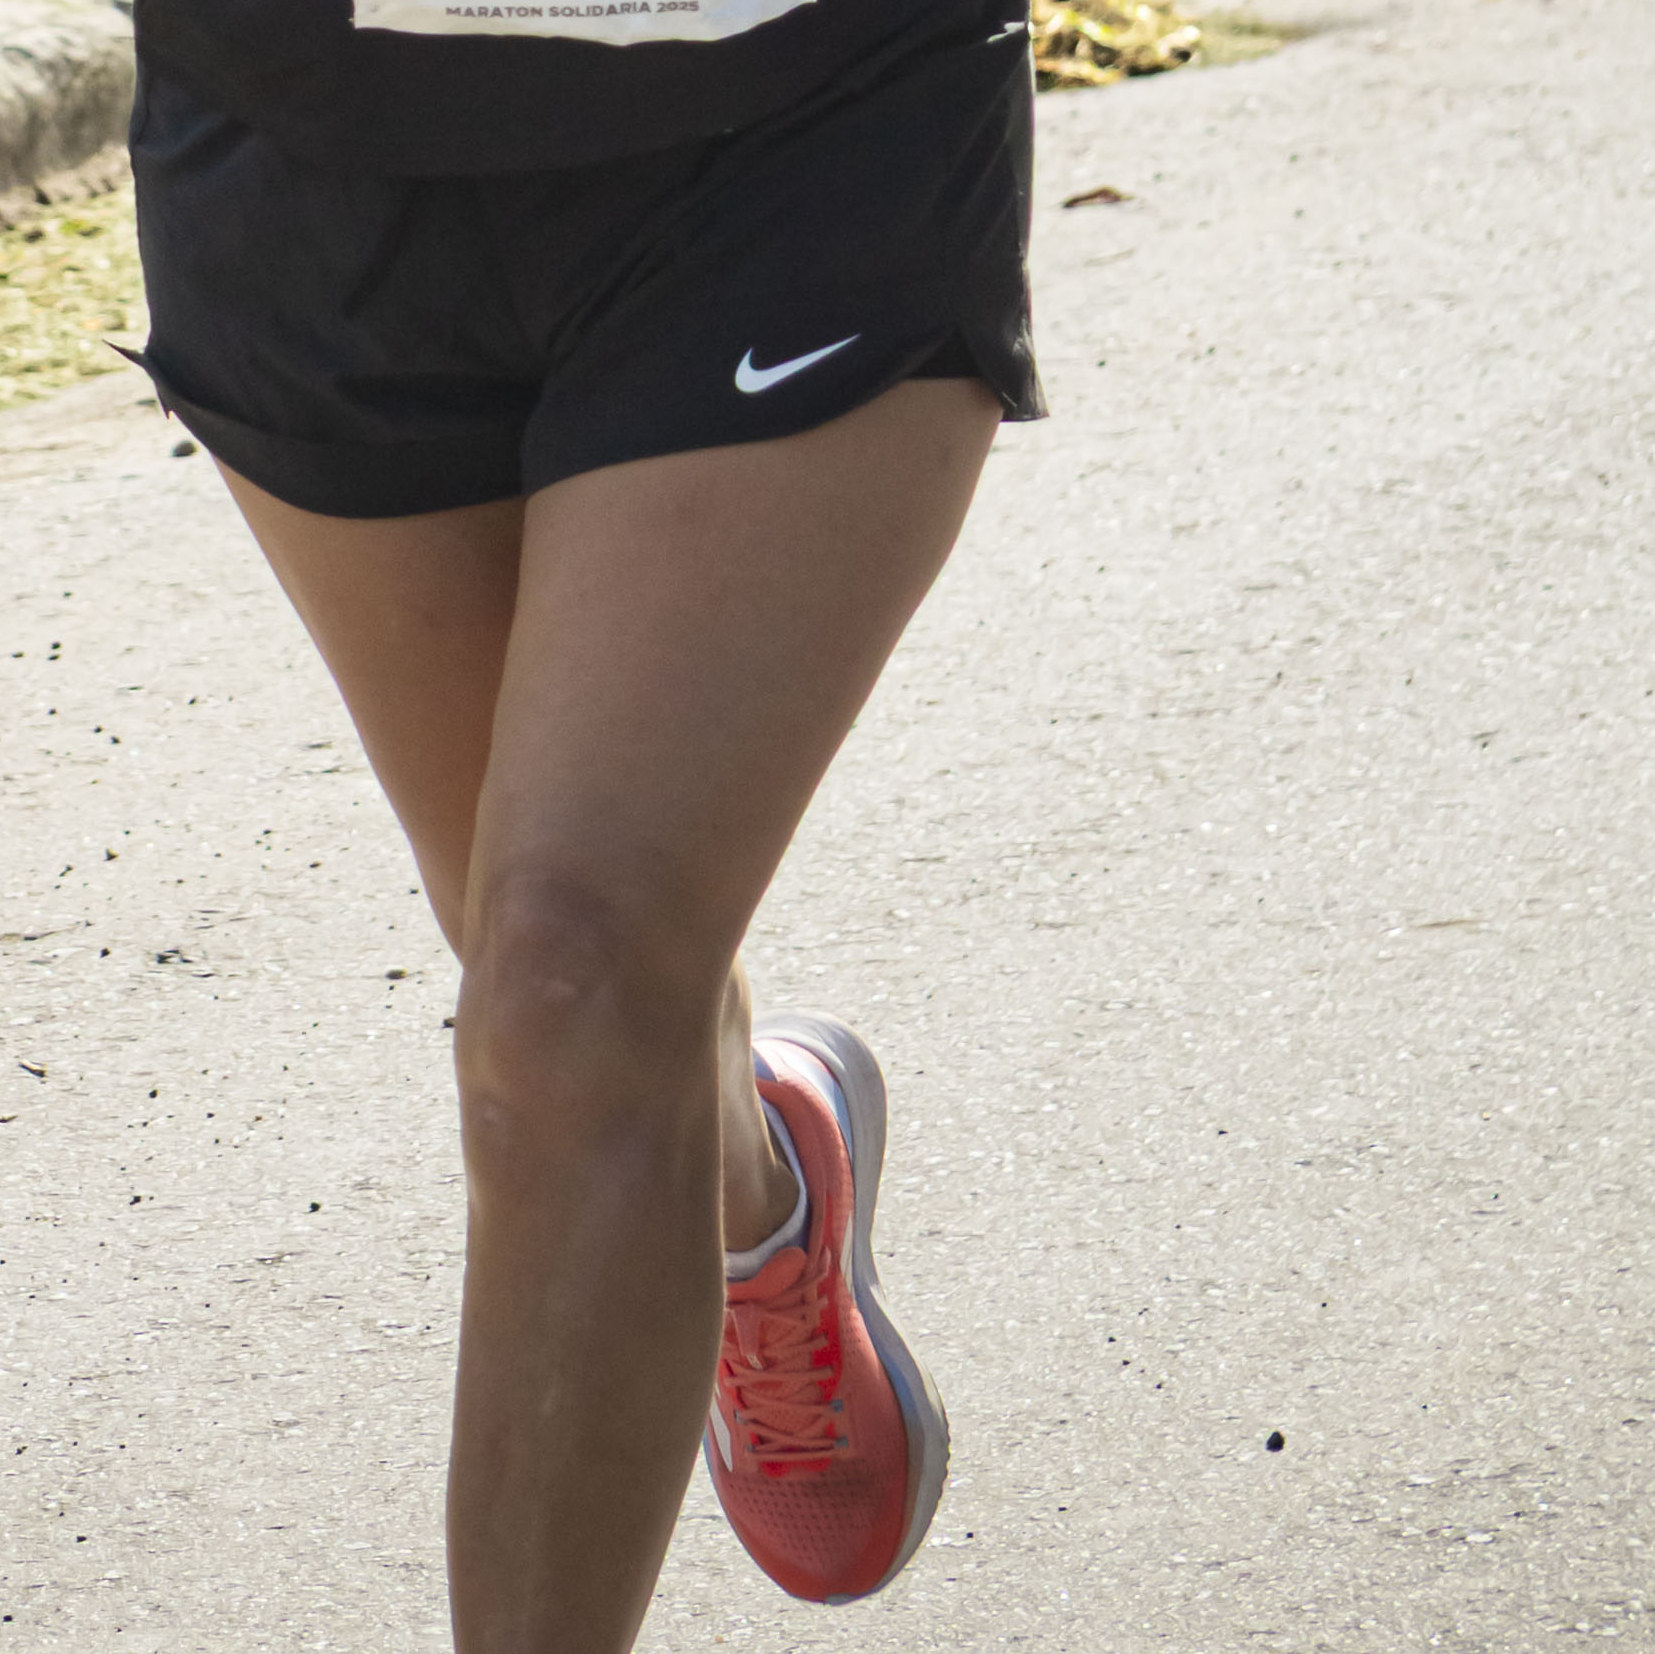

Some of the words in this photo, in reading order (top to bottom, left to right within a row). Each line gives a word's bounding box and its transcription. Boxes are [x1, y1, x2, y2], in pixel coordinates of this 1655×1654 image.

[446, 6, 543, 18] MARATON
[549, 1, 650, 18] SOLIDARIA
[656, 0, 699, 13] 2025
